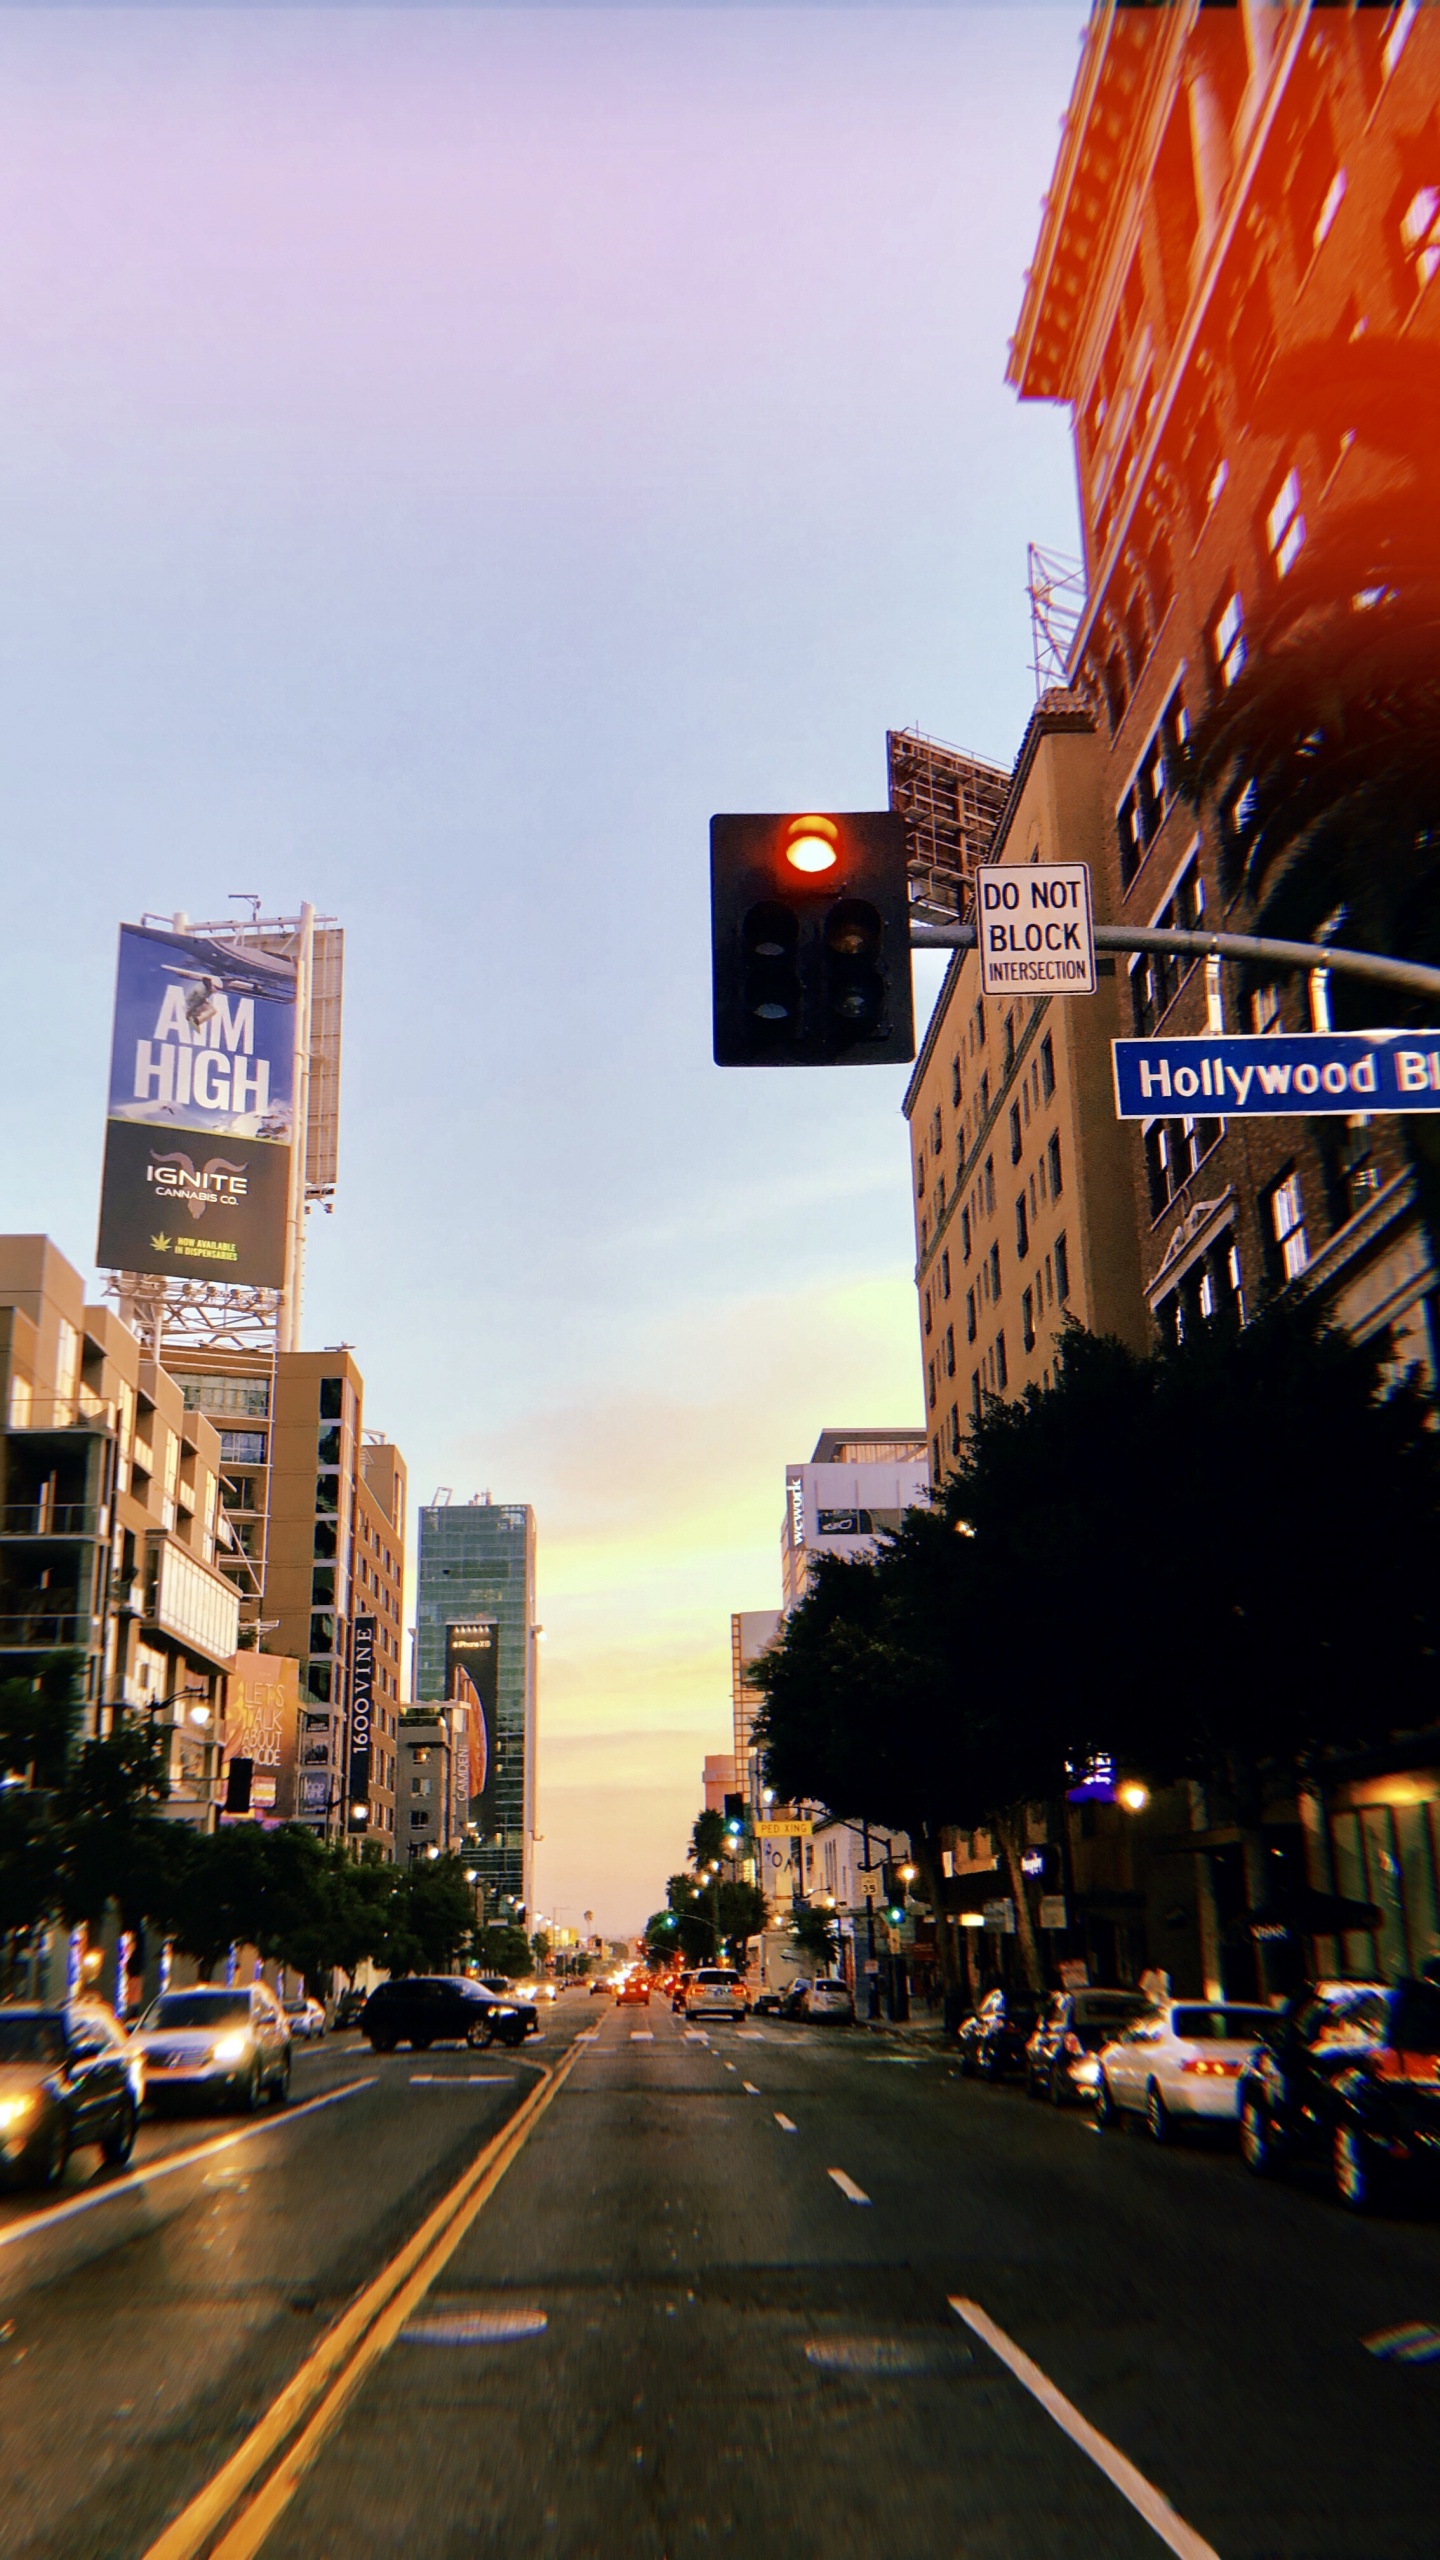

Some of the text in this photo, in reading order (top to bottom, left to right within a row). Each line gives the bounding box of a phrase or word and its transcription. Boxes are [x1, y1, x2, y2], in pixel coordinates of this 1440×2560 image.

[984, 881, 1081, 910] DO NOT
[989, 923, 1081, 952] BLOCK
[989, 960, 1086, 981] INTERSECTION
[134, 1039, 270, 1114] HIGH
[1139, 1053, 1379, 1105] Hollywood
[146, 1165, 248, 1195] IGNITE
[155, 1187, 239, 1206] CANNABIS CO.
[174, 1245, 238, 1261] IN DISPENSARIES
[177, 1237, 236, 1252] NOW AVAILABLE
[786, 1477, 804, 1546] wework
[244, 1682, 285, 1707] LET'S
[353, 1628, 372, 1753] 1600 VINE
[242, 1704, 283, 1731] TALK
[241, 1728, 282, 1749] ABOUT
[457, 1748, 469, 1801] CAMDEN
[761, 1823, 807, 1833] PED XING
[863, 1884, 877, 1893] 35
